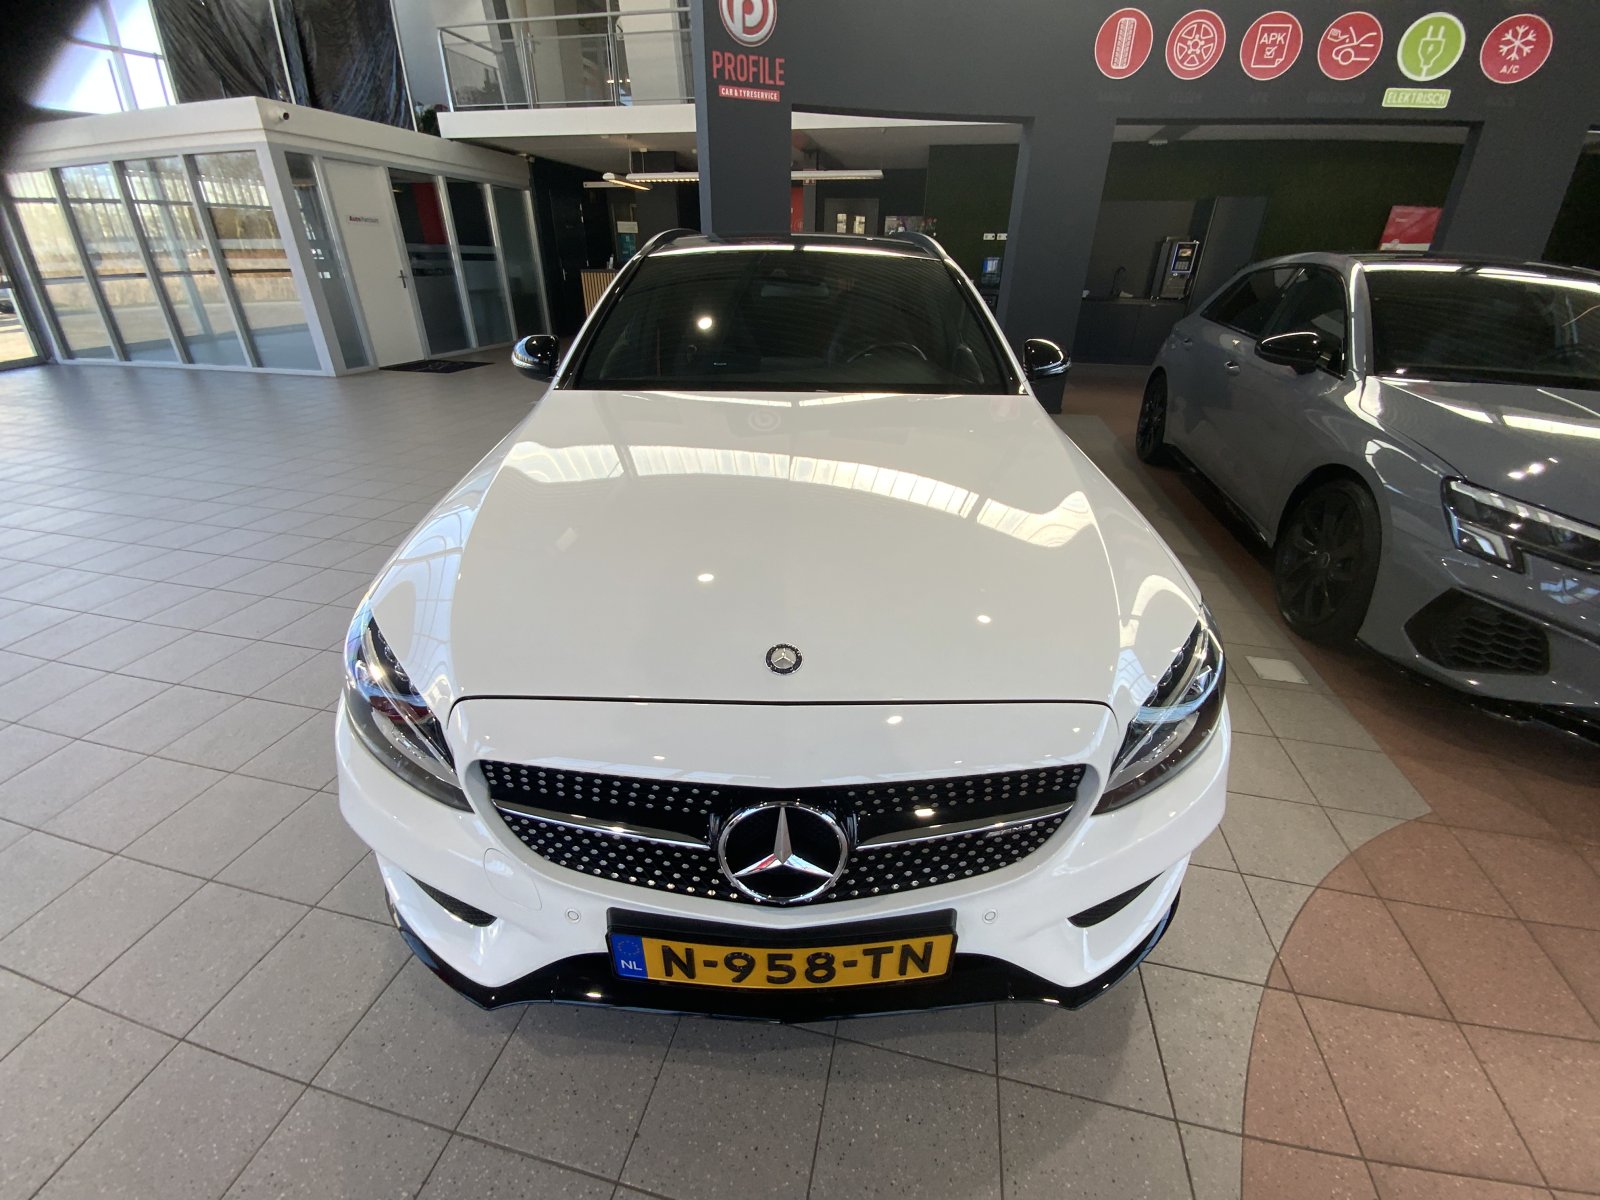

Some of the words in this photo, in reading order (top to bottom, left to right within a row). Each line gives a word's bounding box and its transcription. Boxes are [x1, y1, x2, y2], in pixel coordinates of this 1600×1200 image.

[1259, 32, 1285, 45] APK
[712, 50, 785, 86] PROFILE
[1499, 65, 1519, 74] A/C
[721, 87, 733, 96] CAR
[1387, 91, 1446, 105] ELEKTRISCH
[621, 959, 643, 972] NL
[661, 941, 933, 984] N-958-TN
